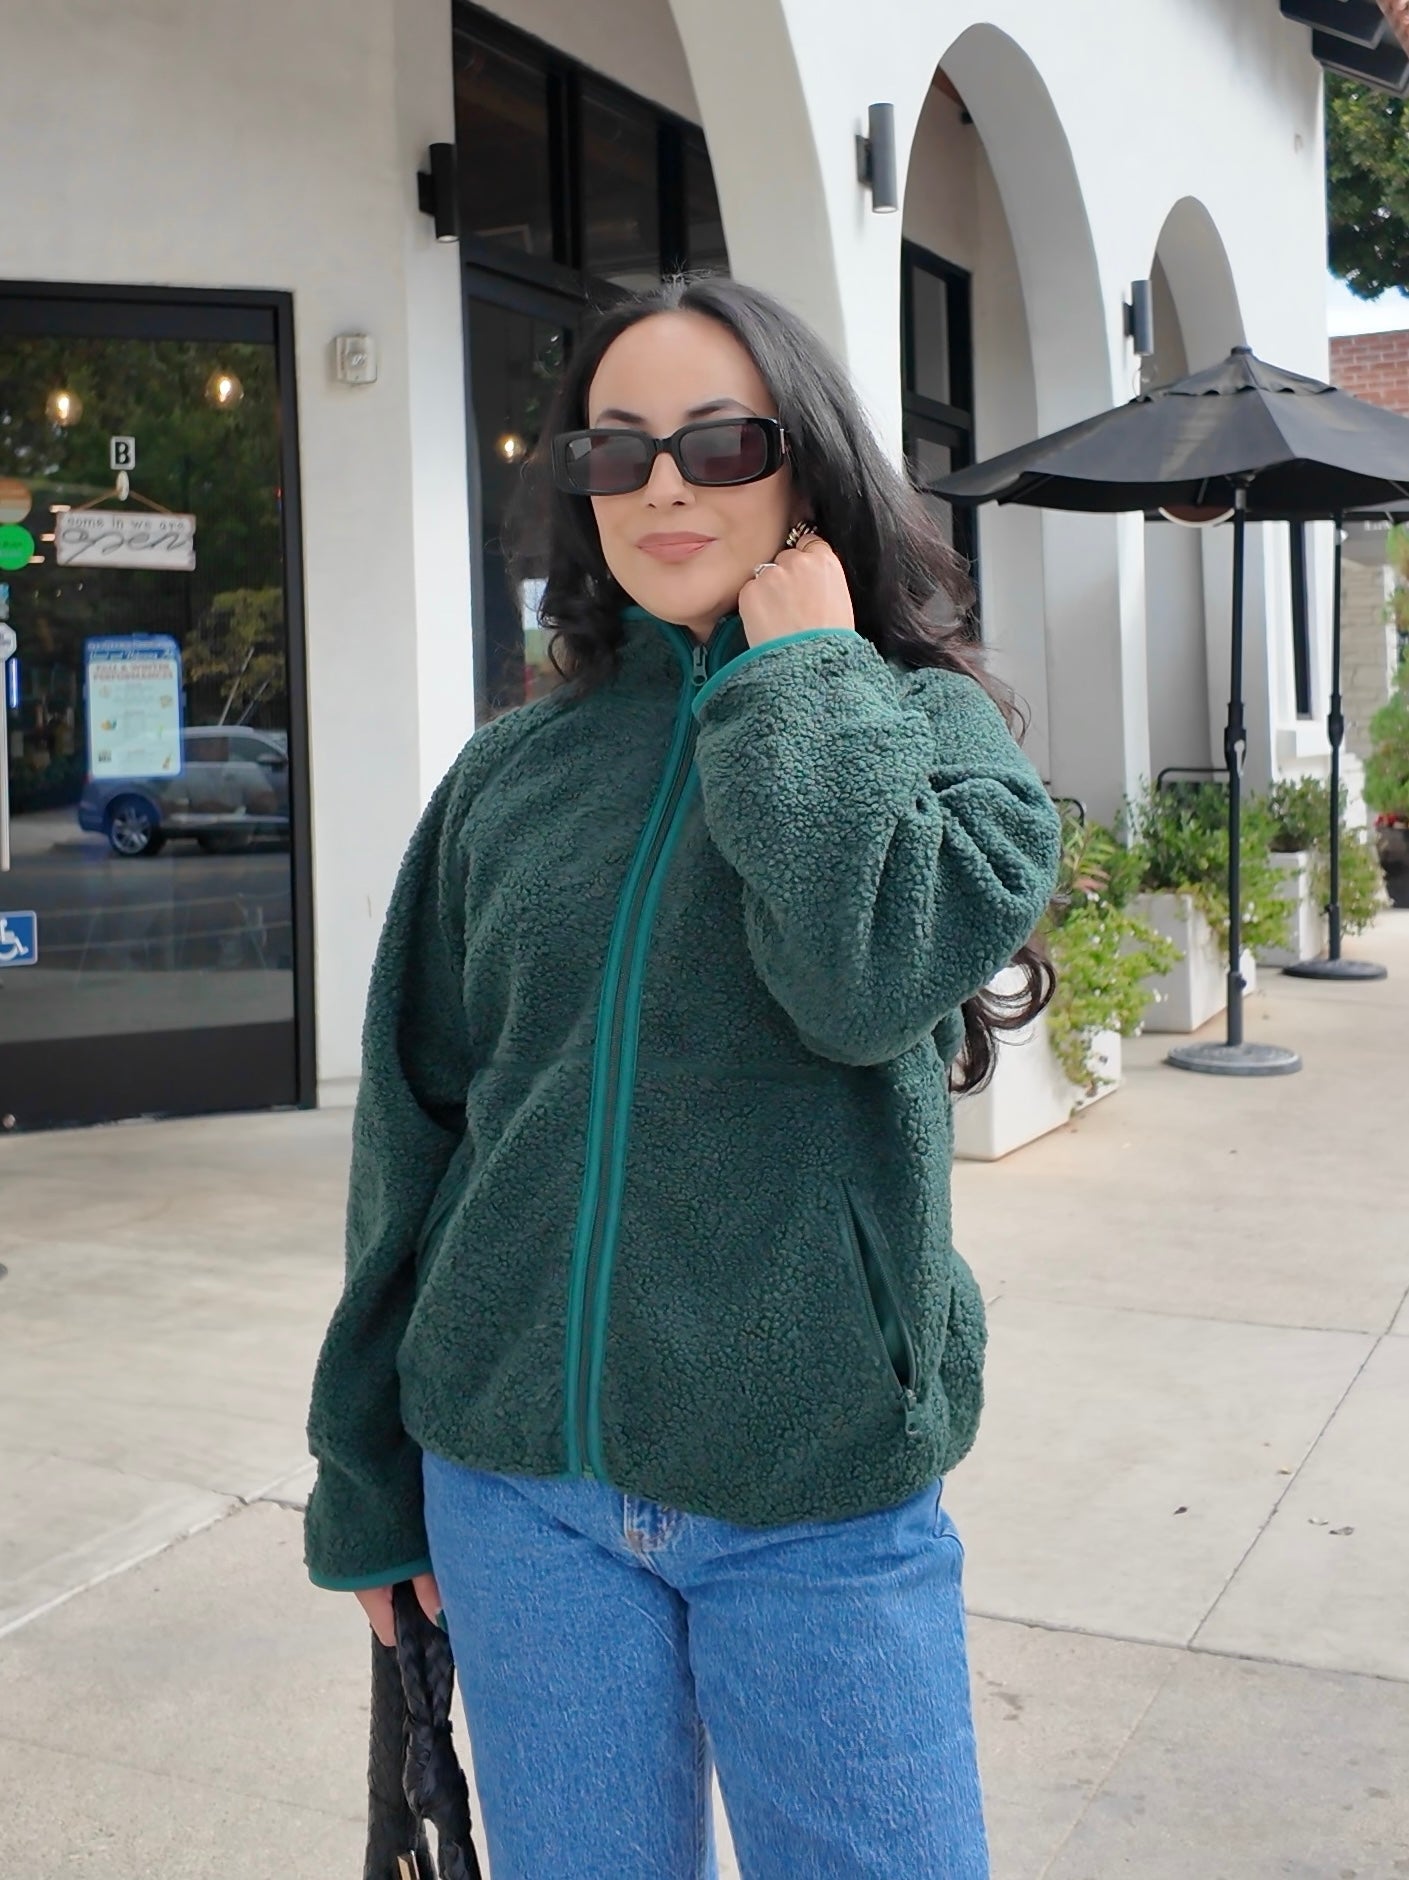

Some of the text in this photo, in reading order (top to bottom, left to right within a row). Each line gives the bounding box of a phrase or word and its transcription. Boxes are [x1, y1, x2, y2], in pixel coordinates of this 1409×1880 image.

[115, 441, 130, 465] B
[66, 516, 185, 531] come in we are
[62, 528, 187, 565] open
